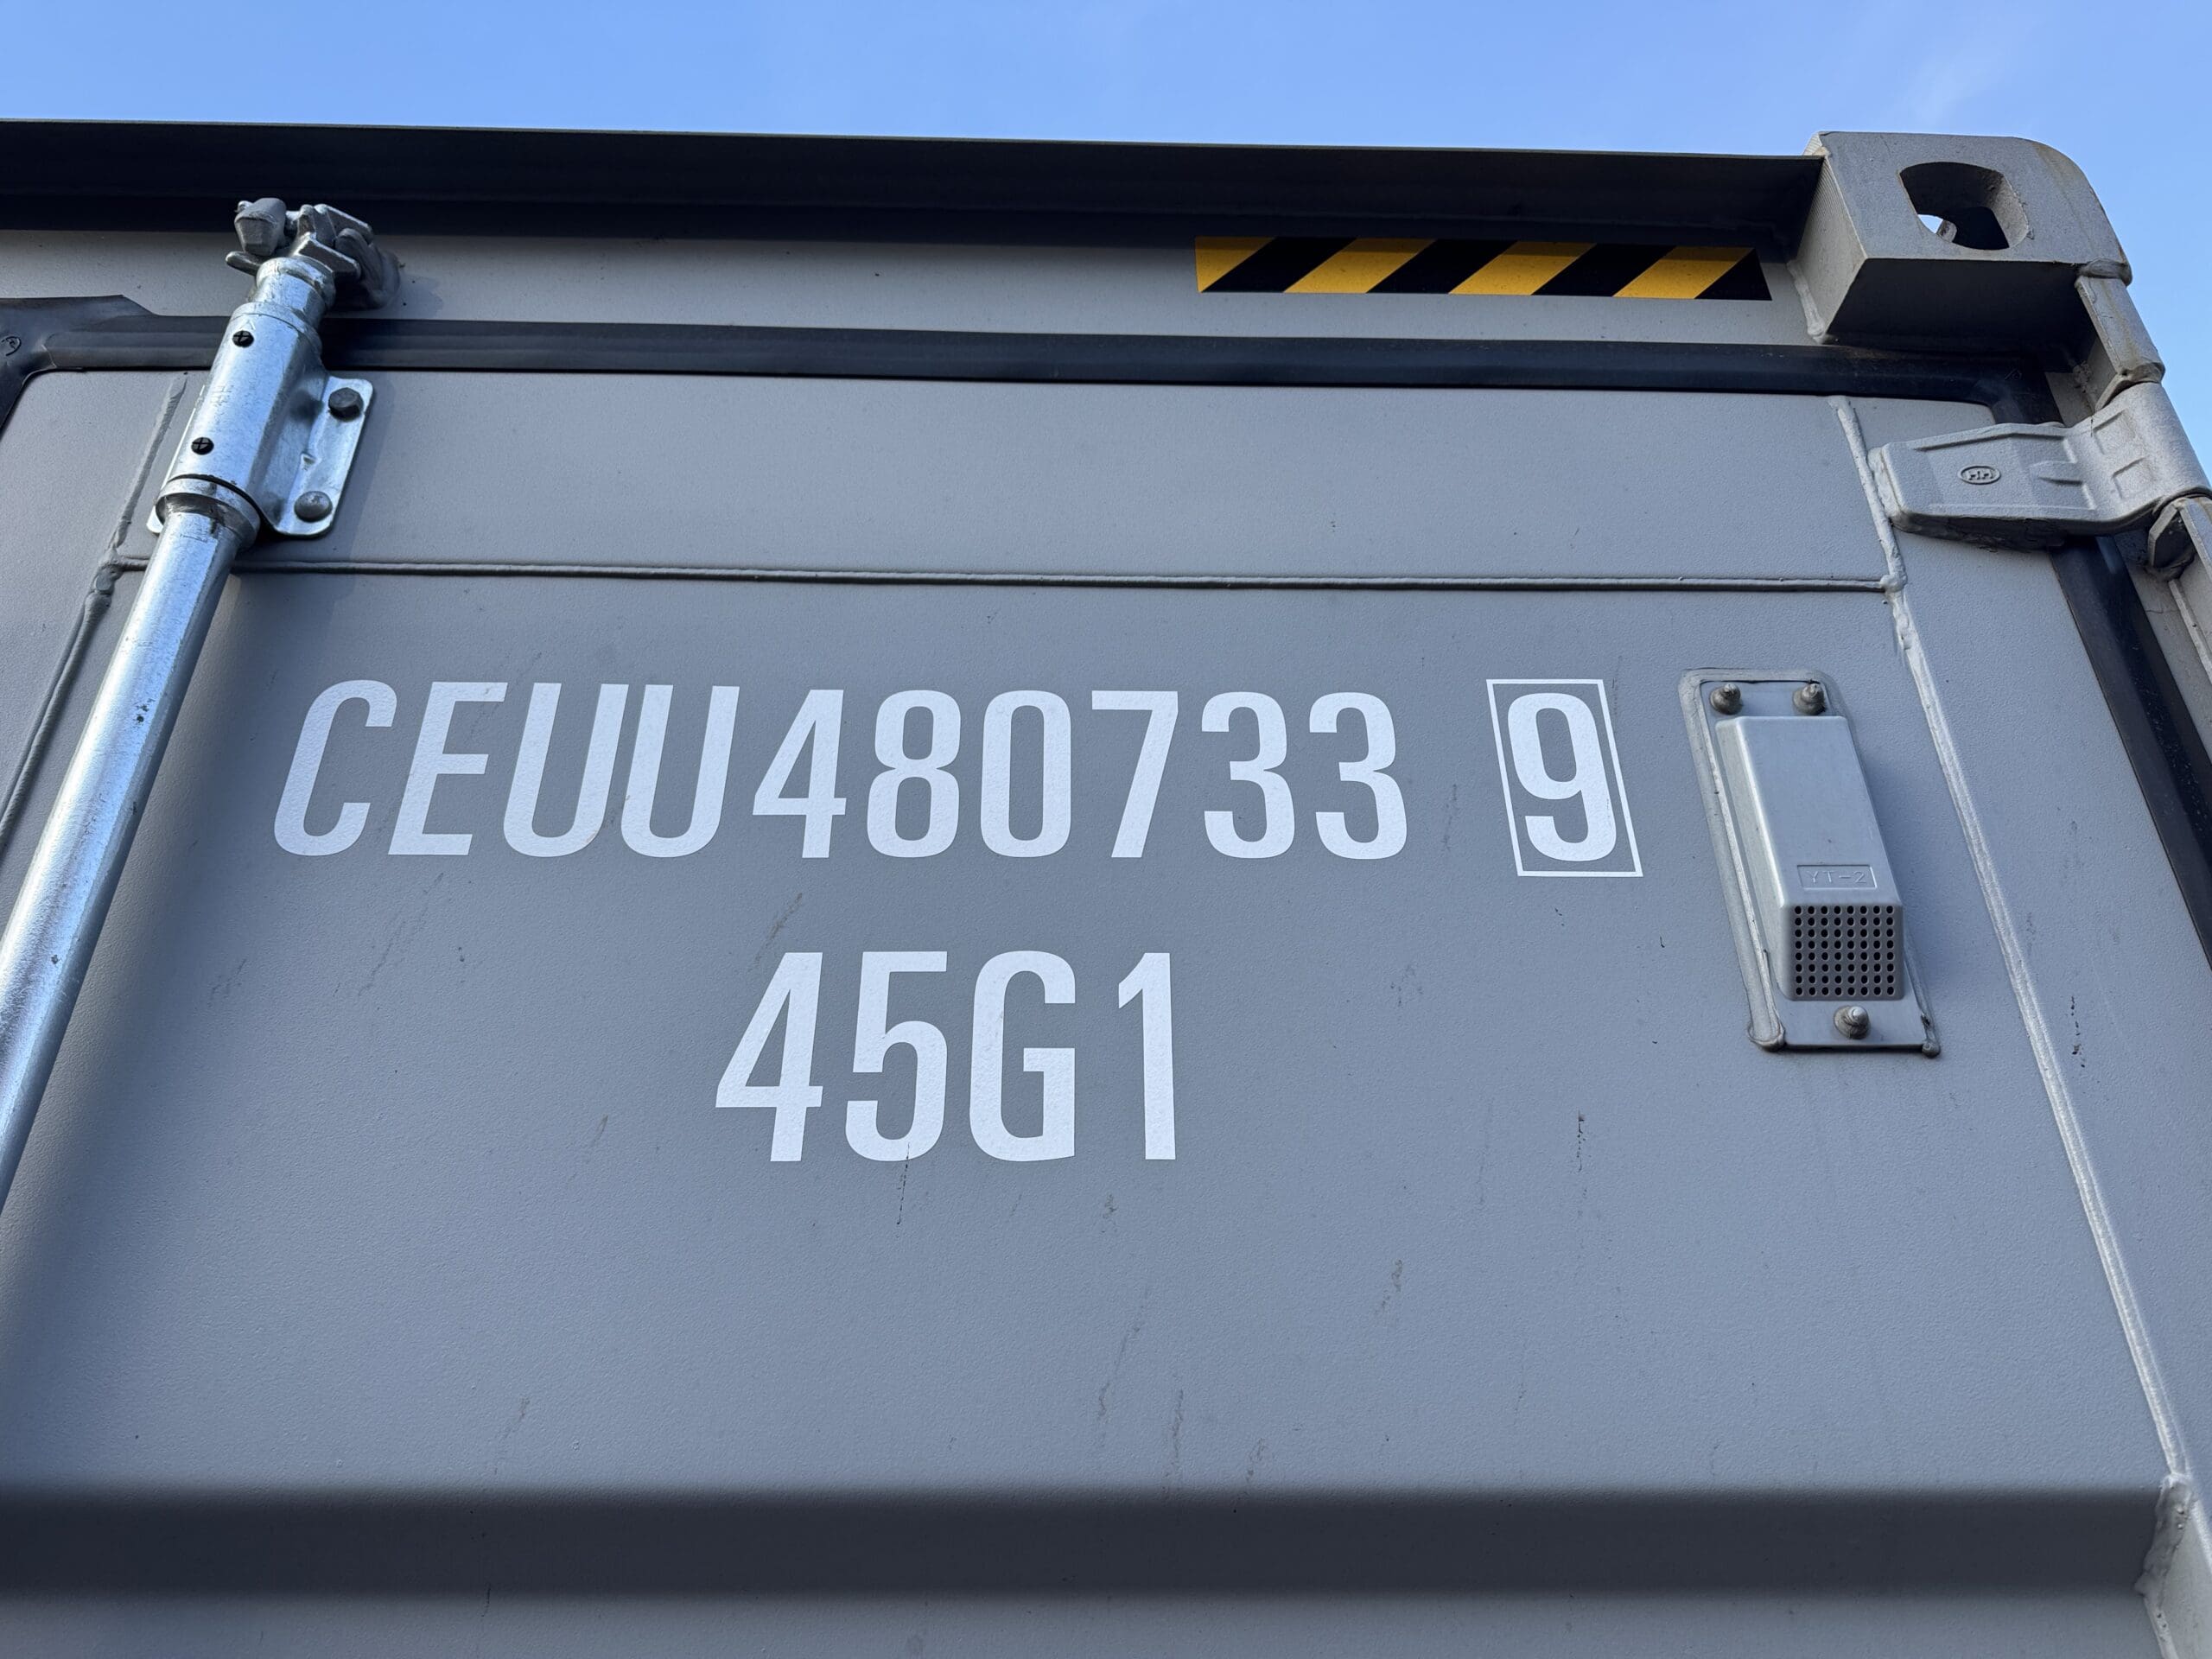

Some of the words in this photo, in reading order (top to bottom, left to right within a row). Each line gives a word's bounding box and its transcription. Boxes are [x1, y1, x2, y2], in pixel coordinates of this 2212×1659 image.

[1507, 692, 1618, 862] 9
[1805, 870, 1867, 884] YT-2
[715, 950, 1177, 1162] 45G1
